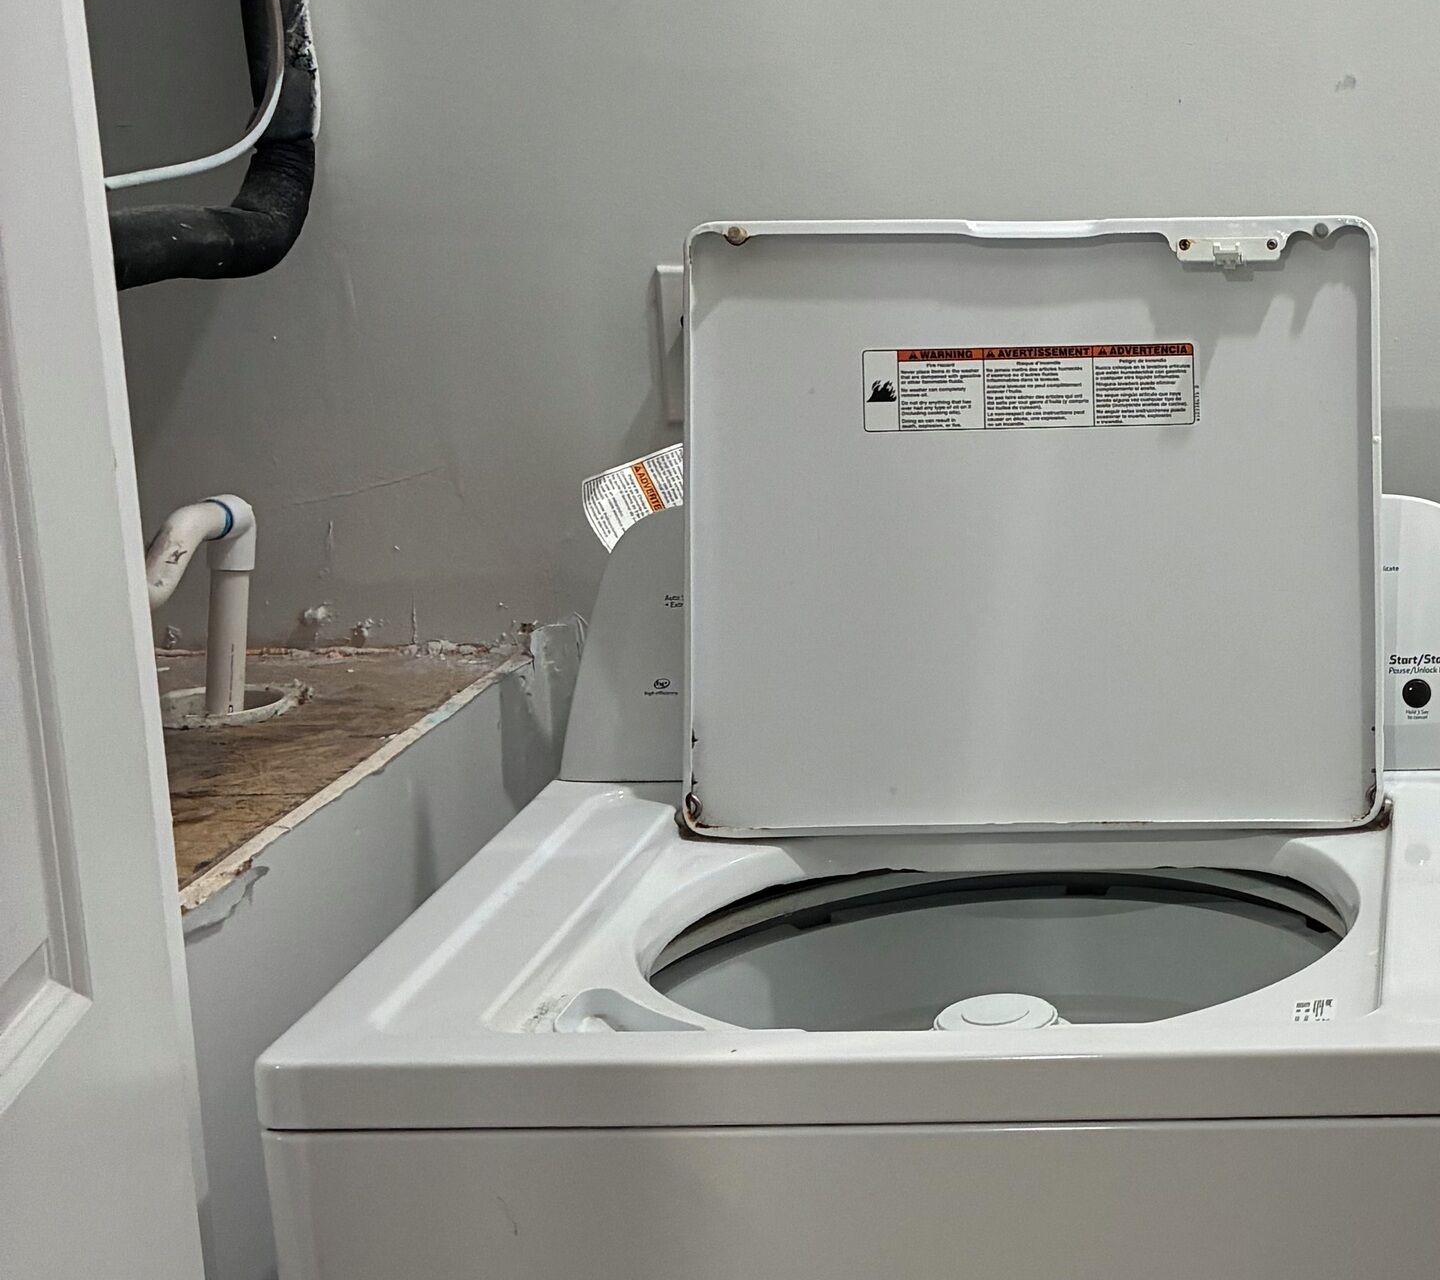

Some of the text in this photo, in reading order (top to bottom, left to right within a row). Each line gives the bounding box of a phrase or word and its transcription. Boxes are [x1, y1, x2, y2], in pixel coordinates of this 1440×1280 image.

[998, 348, 1090, 358] AVERTISSEMENT
[1109, 345, 1188, 355] ADVERTENCIA
[920, 351, 973, 359] WARNING
[1388, 666, 1438, 675] Pause/Unlock
